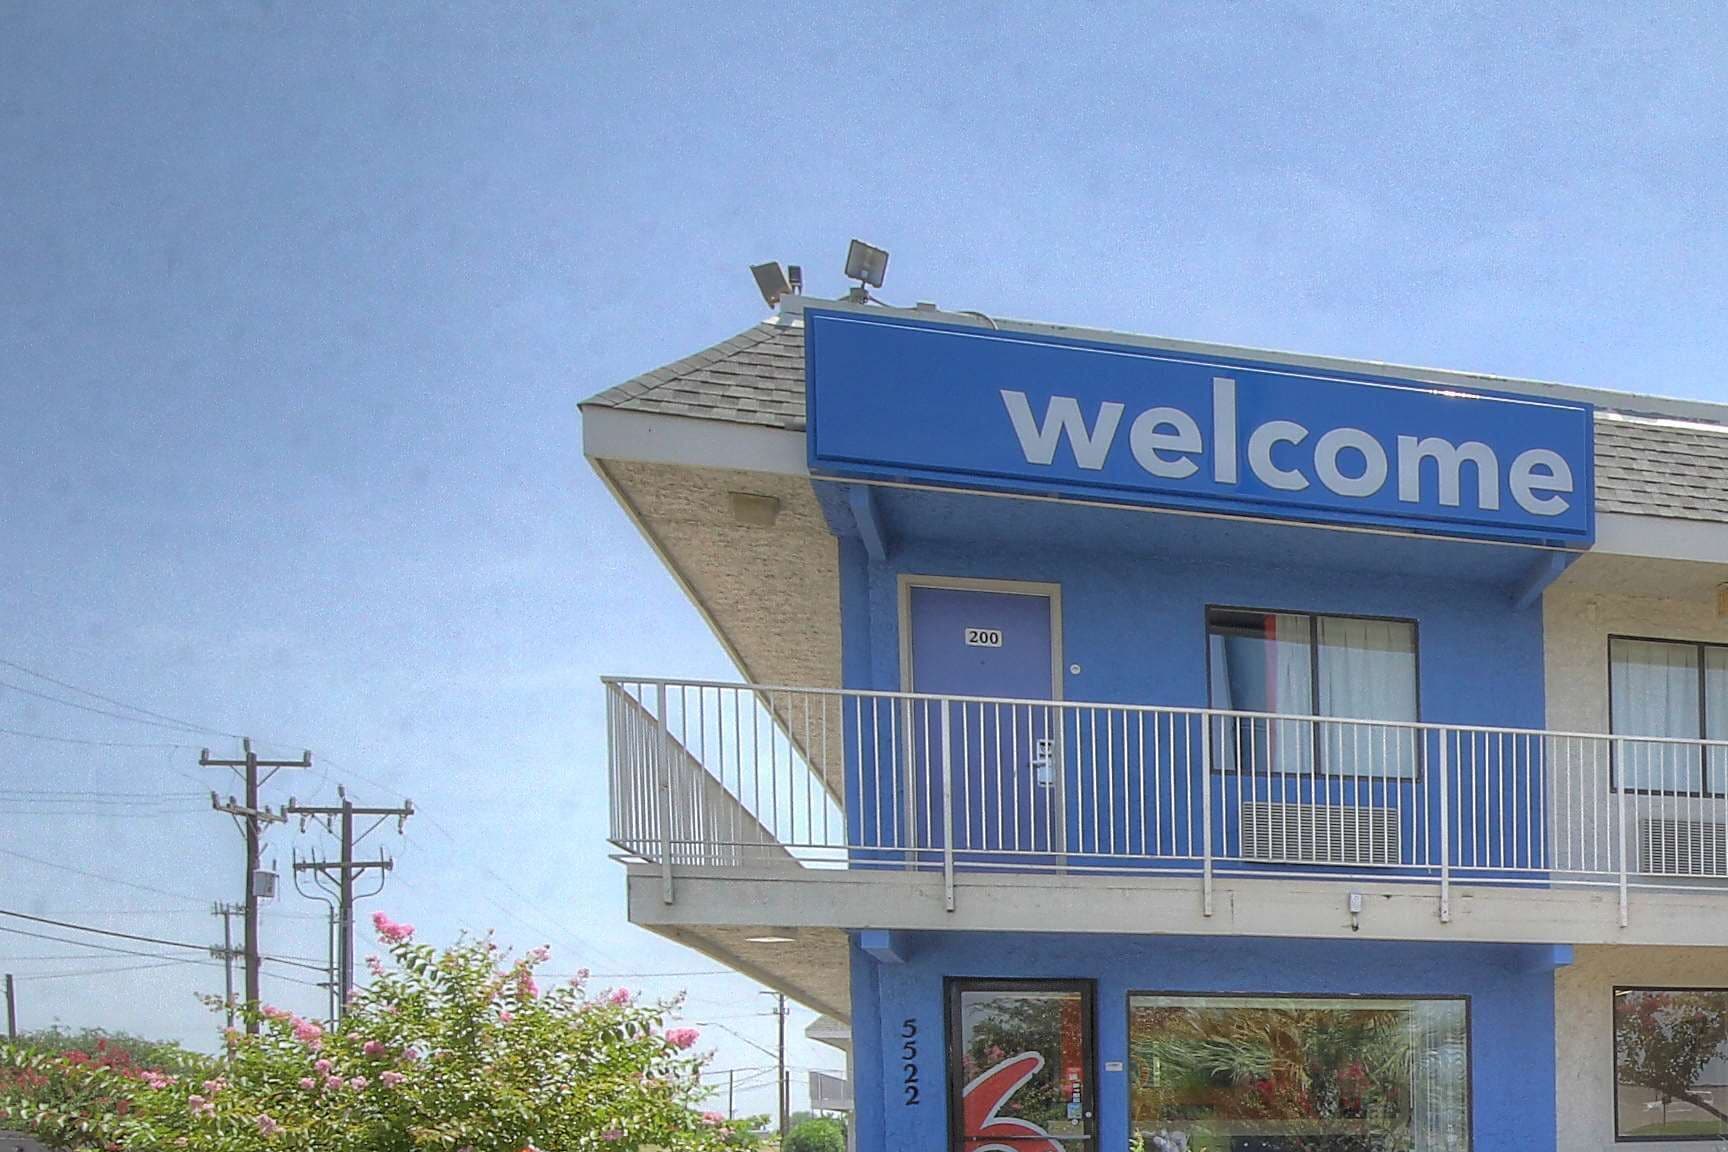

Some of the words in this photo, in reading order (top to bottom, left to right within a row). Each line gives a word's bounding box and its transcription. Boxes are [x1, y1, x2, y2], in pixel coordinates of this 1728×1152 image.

[1000, 377, 1574, 516] welcome
[968, 630, 999, 645] 200
[901, 1018, 921, 1106] 5522
